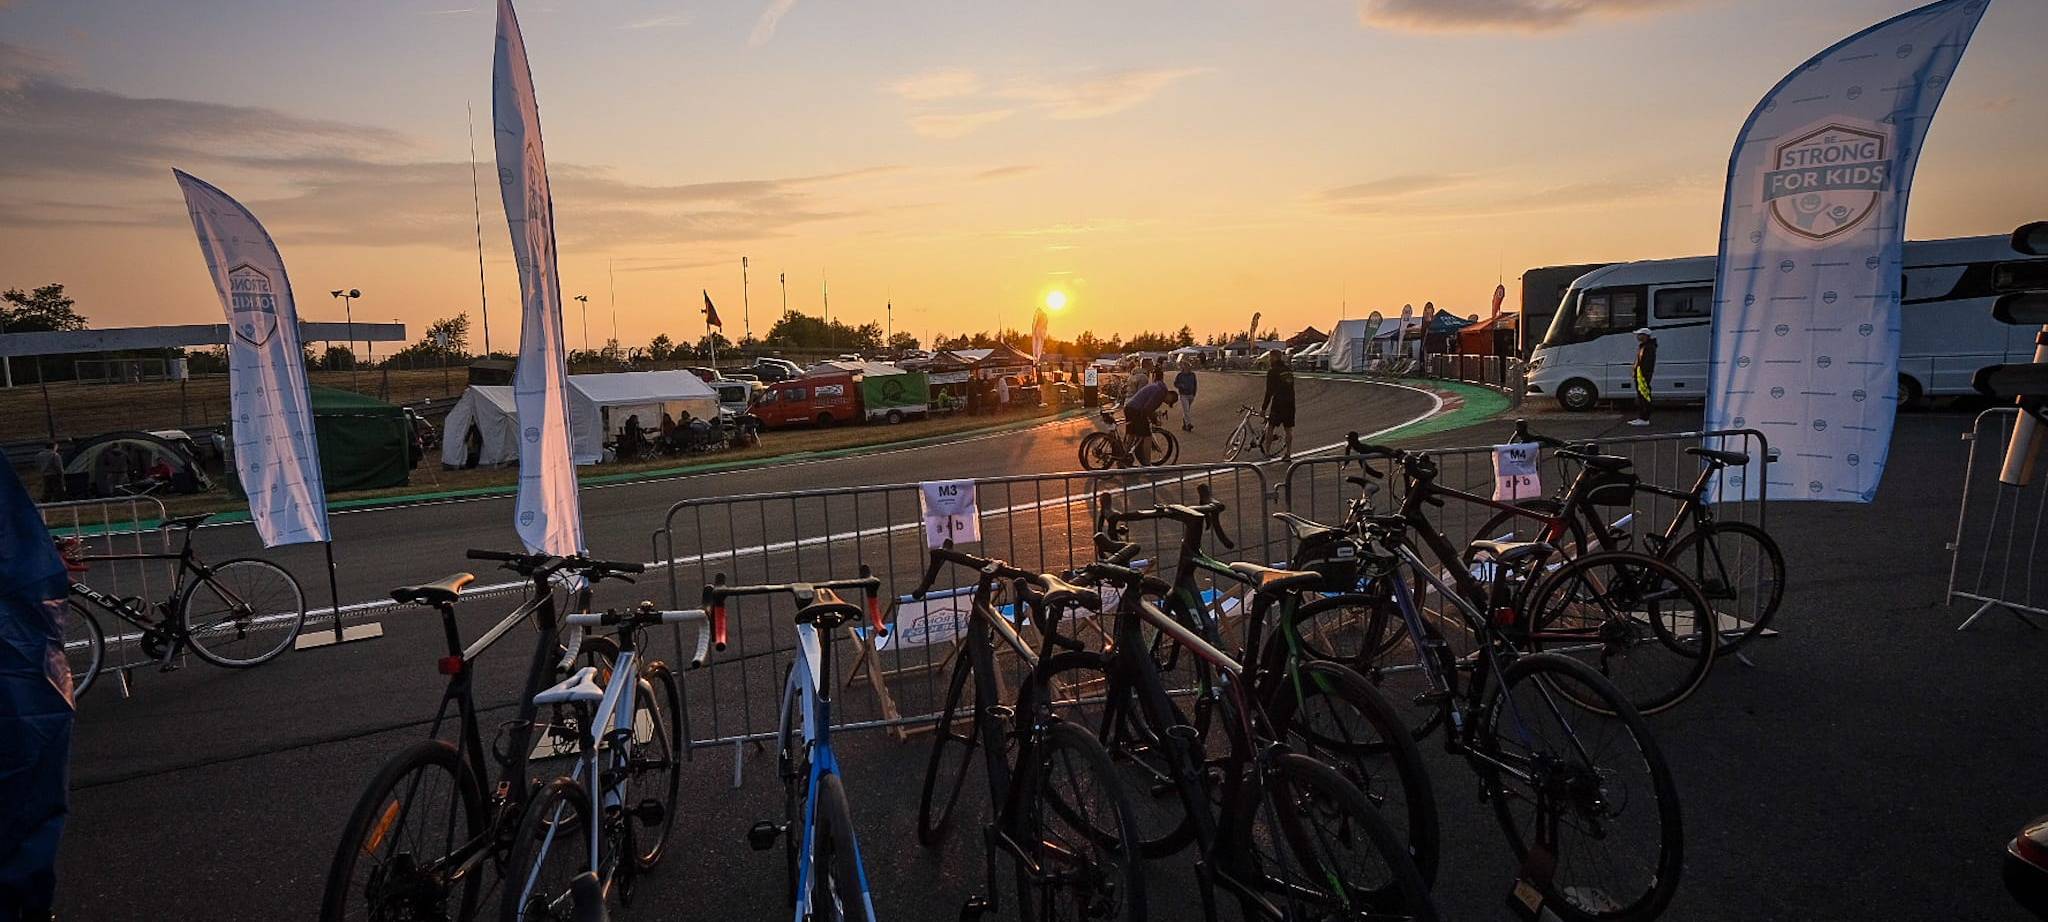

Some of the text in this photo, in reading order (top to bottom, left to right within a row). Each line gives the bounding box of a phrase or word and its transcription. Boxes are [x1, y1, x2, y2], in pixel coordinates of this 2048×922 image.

[1824, 135, 1837, 144] BE
[1783, 142, 1875, 166] STRONG
[1771, 165, 1884, 193] FOR KIDS
[1510, 449, 1526, 459] M4
[1522, 476, 1530, 486] b
[938, 484, 958, 497] M3
[955, 519, 965, 531] b
